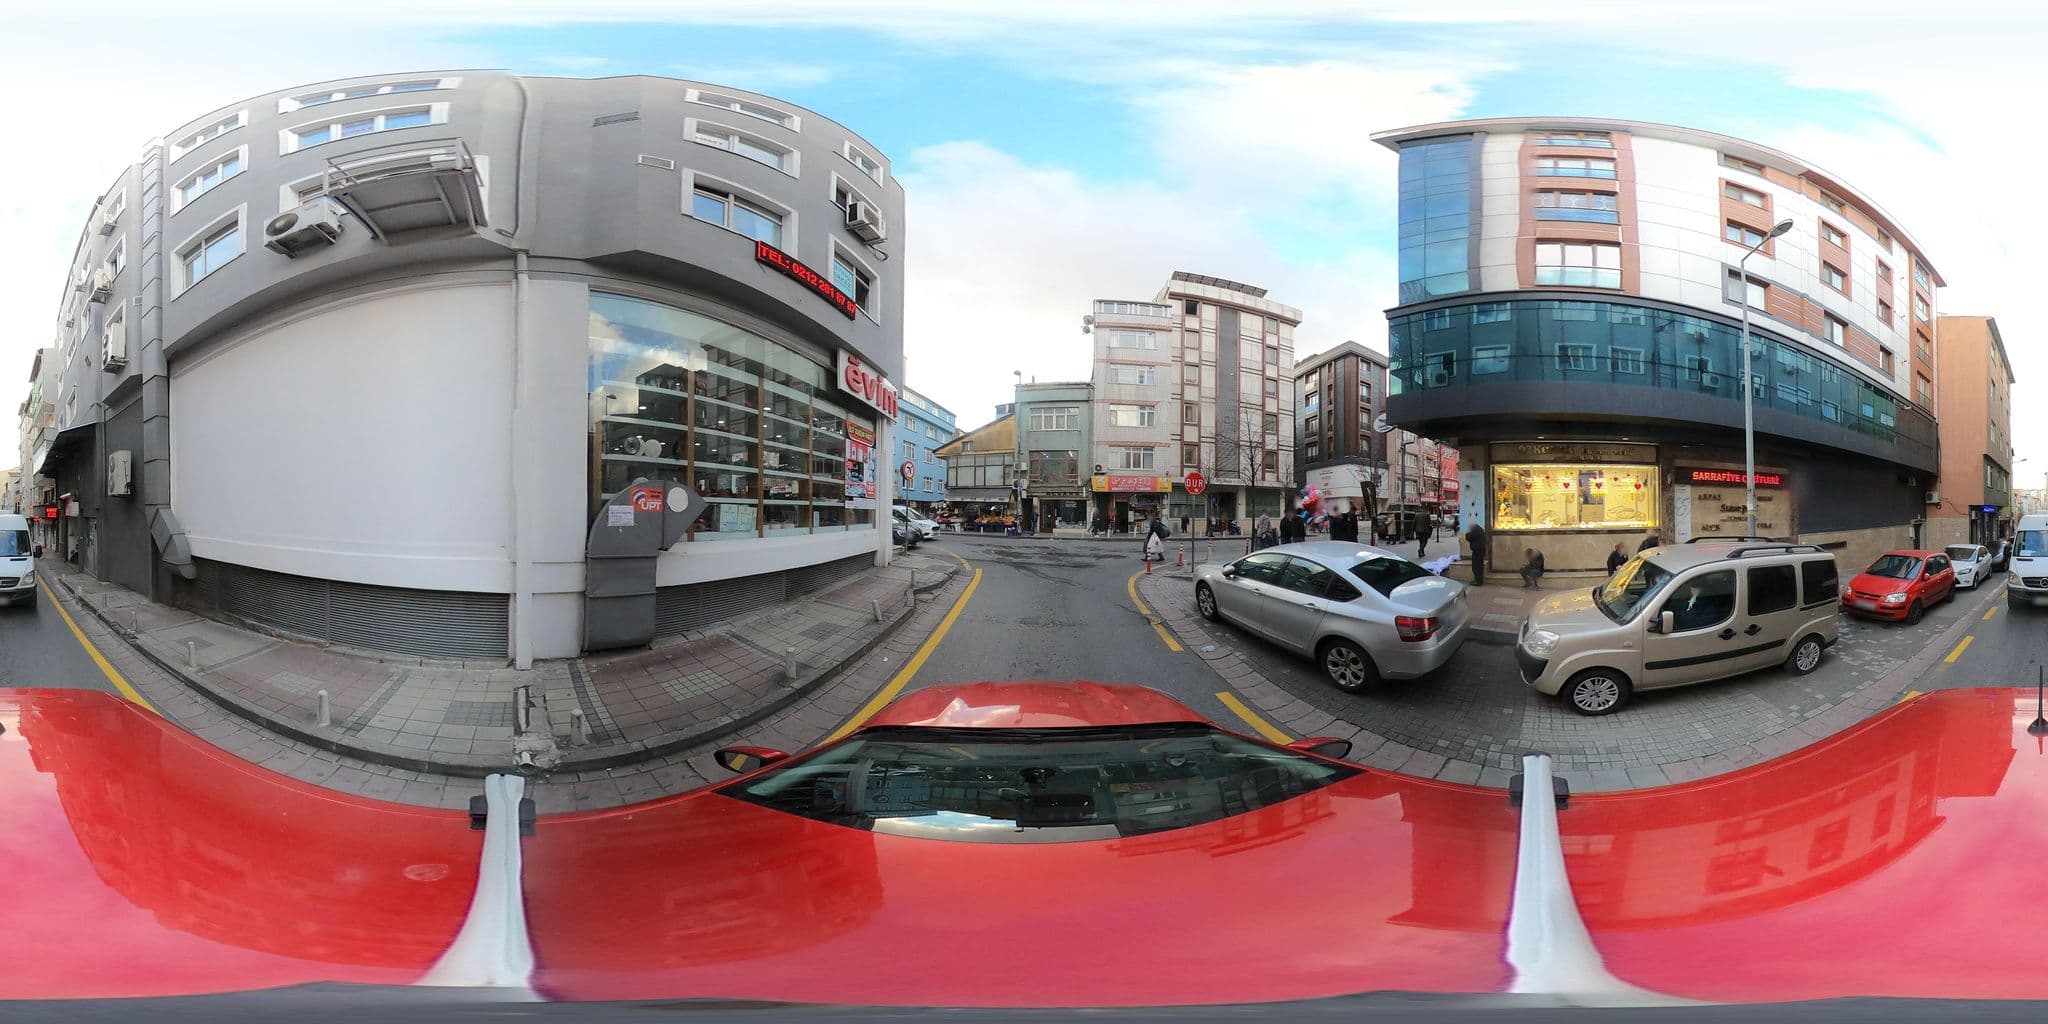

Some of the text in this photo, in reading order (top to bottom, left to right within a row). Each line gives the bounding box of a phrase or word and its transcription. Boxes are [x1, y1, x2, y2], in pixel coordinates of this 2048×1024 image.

[760, 245, 789, 268] TEL:
[792, 263, 818, 286] 0212
[1692, 471, 1740, 482] SARRAFİYE
[1186, 478, 1203, 487] DUR
[641, 501, 662, 511] UPT
